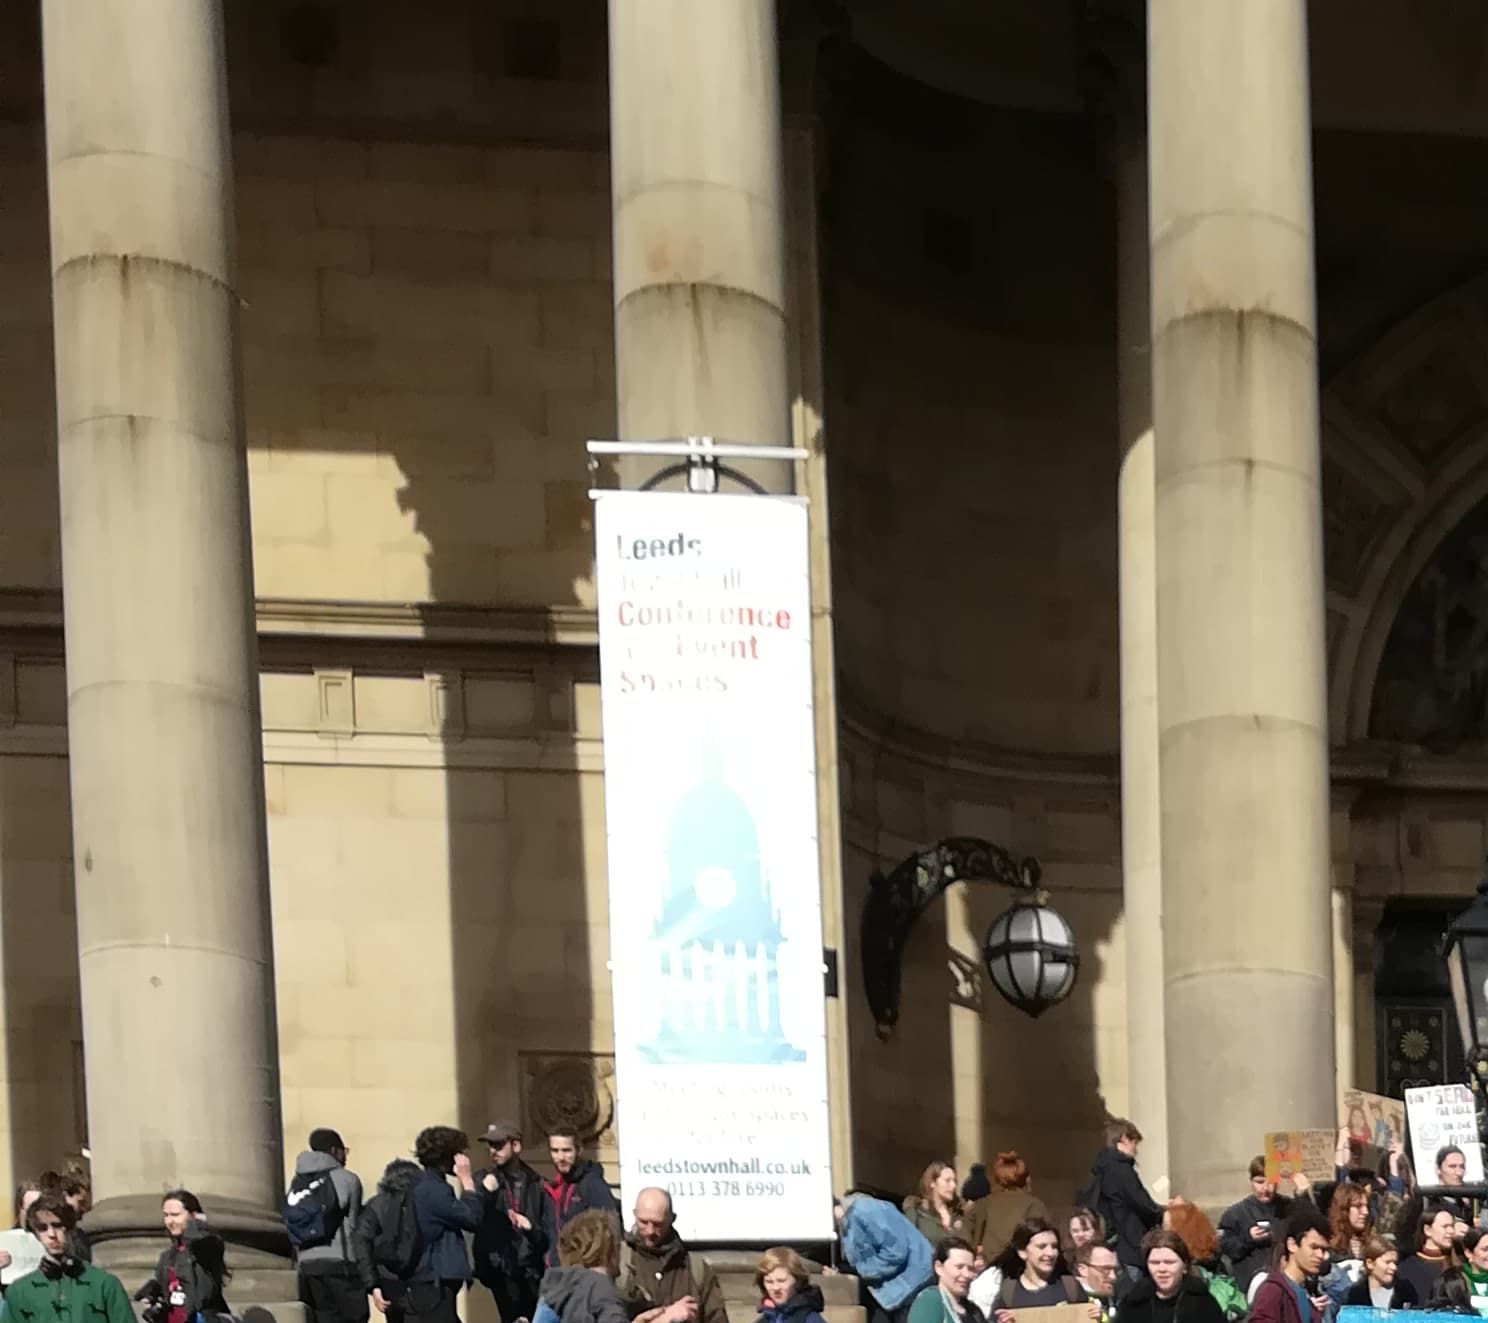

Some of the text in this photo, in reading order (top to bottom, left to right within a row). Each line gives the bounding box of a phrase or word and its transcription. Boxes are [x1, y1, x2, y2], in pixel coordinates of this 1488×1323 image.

[616, 532, 702, 560] Leeds
[638, 1158, 811, 1175] leedstownhall.co.uk
[667, 1181, 785, 1197] 0113 378 6990
